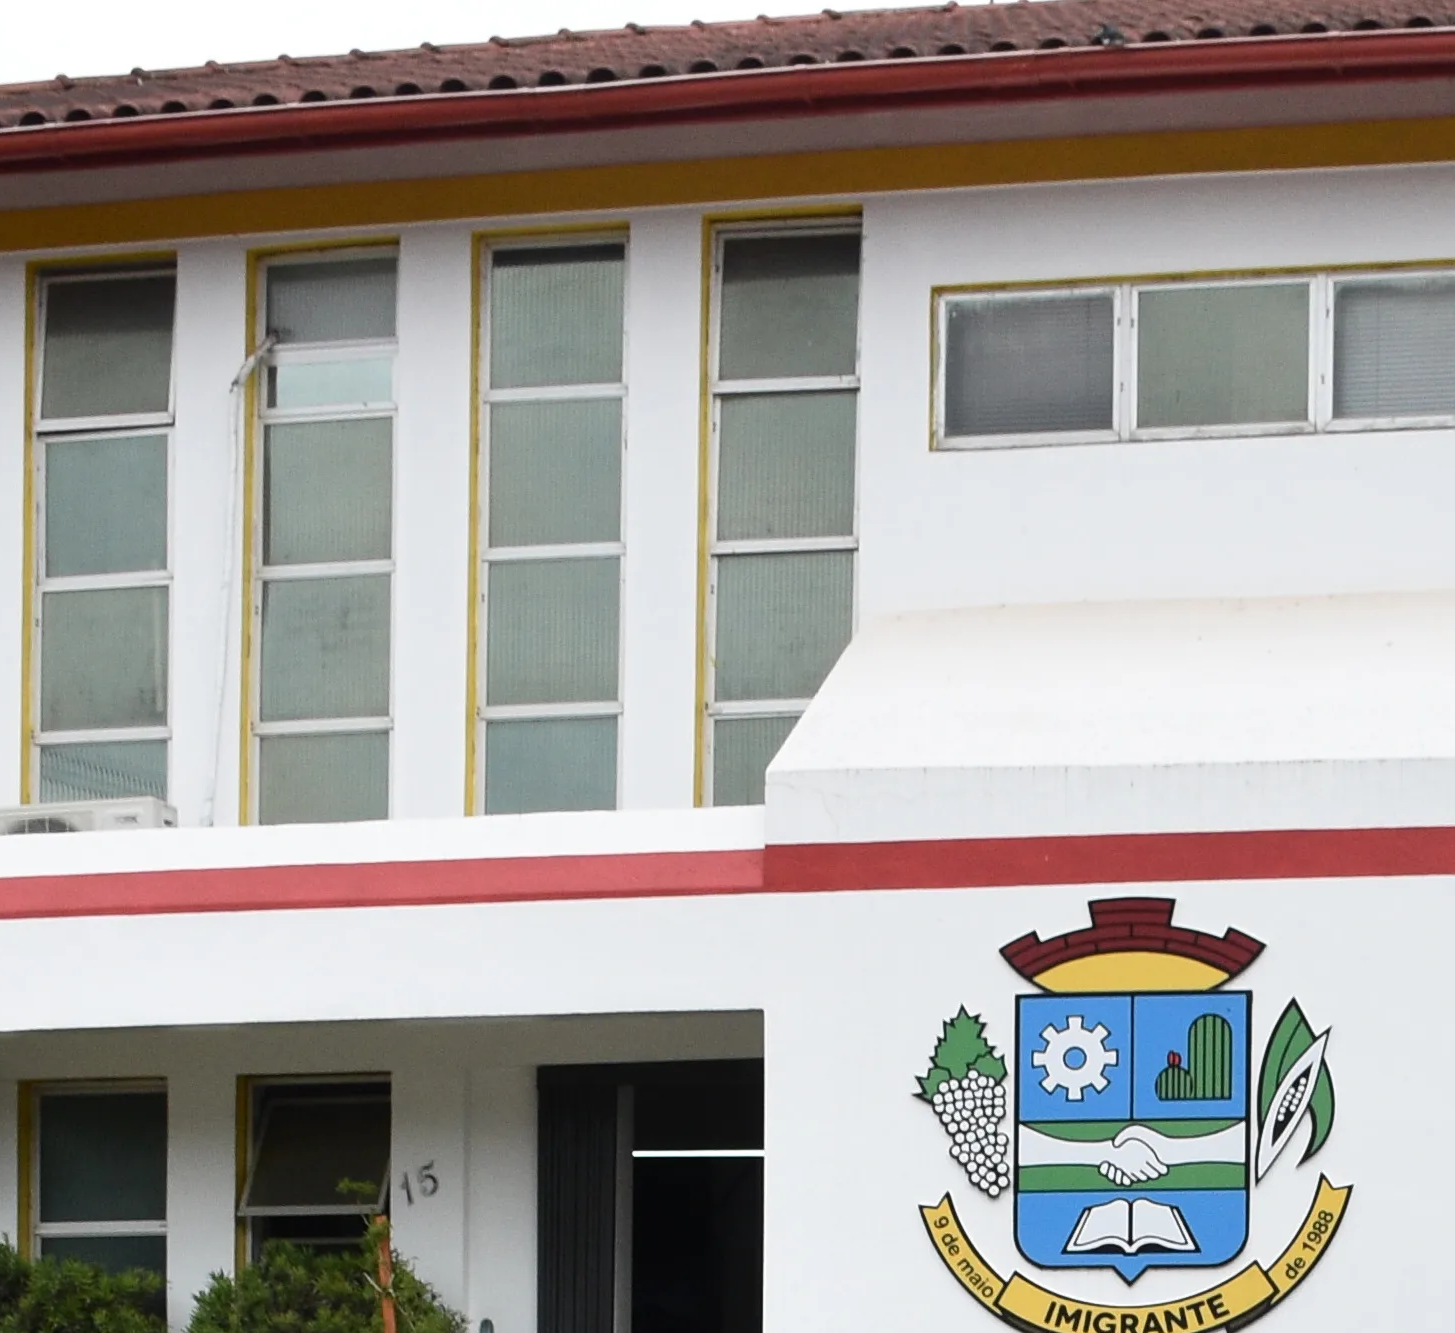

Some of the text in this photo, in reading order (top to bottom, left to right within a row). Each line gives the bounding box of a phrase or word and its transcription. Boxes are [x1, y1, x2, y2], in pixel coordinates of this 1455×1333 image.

[400, 1160, 439, 1207] 15
[934, 1215, 994, 1298] 9 de maio
[1285, 1210, 1334, 1280] de 1988
